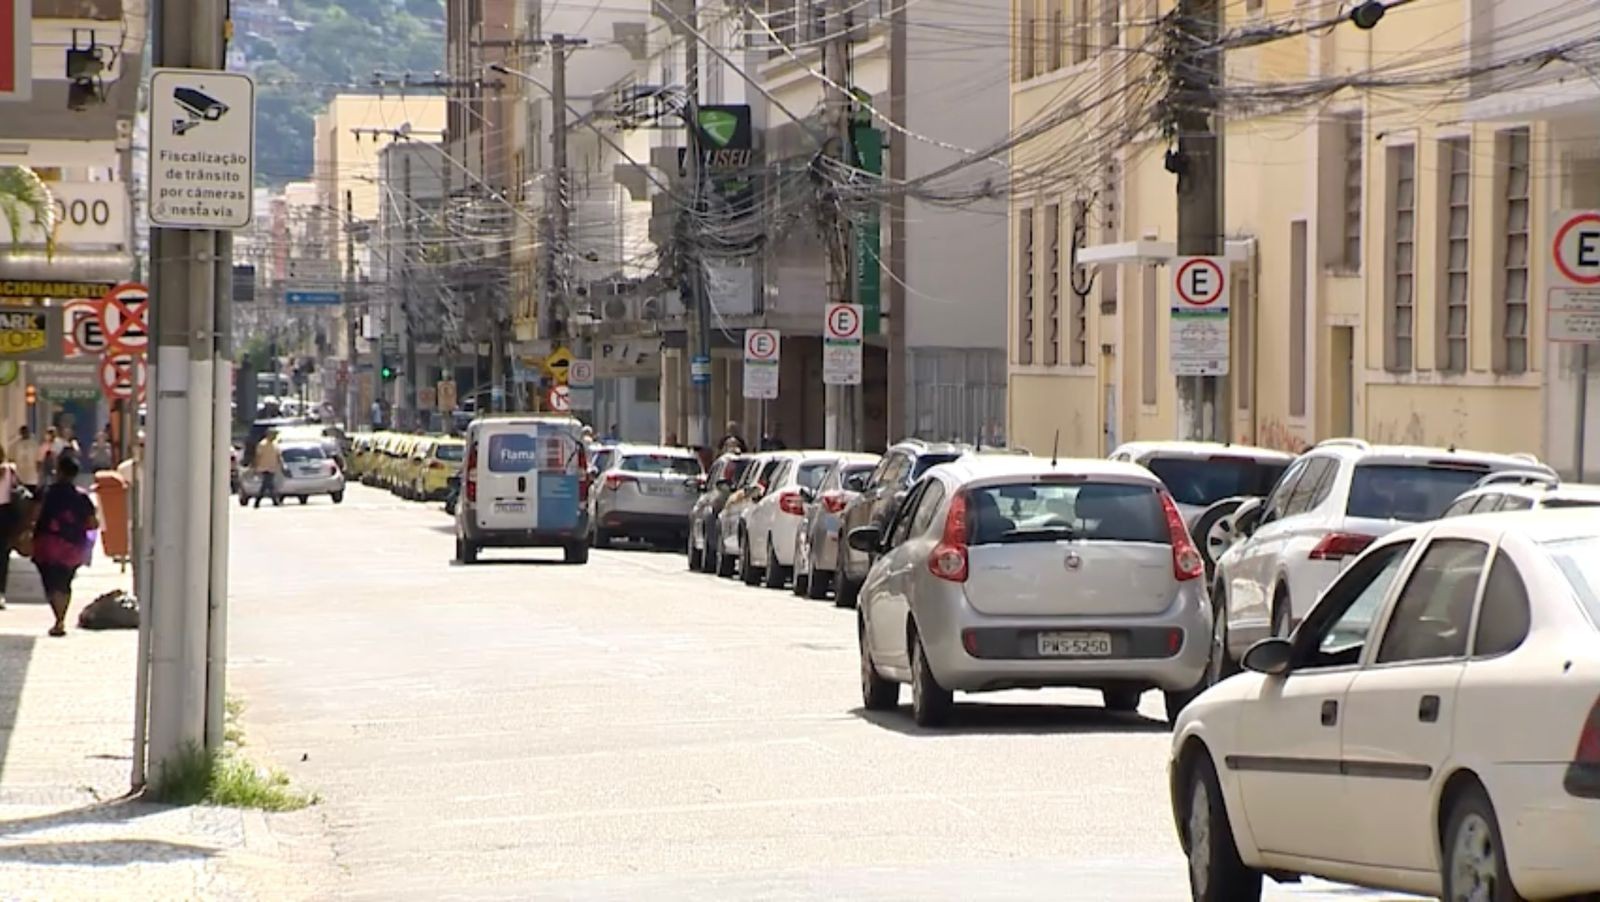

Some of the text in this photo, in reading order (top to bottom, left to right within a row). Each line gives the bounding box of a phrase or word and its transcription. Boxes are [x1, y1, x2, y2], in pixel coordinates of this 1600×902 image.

[160, 150, 247, 166] Fiscalização
[166, 168, 240, 183] de trânsito
[160, 186, 245, 200] por câmeras
[171, 204, 233, 217] nesta via
[1577, 231, 1600, 267] E
[1192, 269, 1208, 296] E
[837, 311, 849, 331] E
[85, 321, 104, 346] E
[757, 336, 768, 352] E
